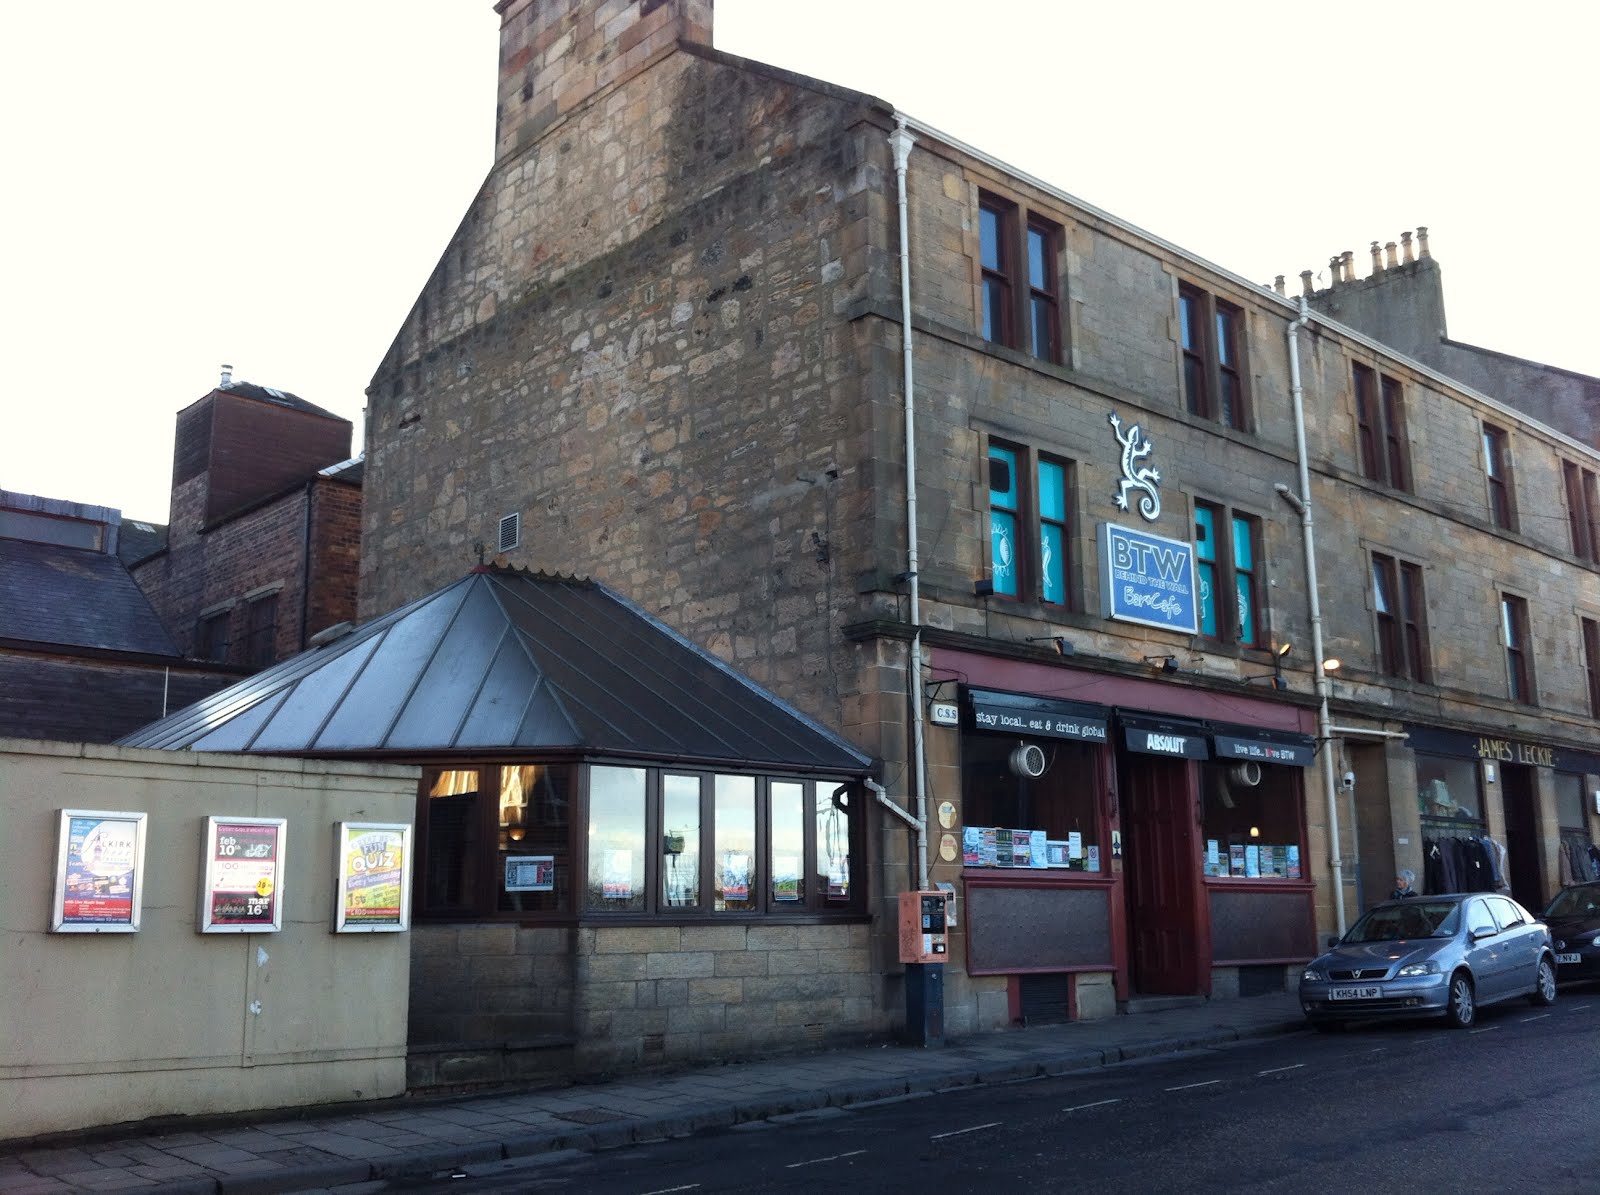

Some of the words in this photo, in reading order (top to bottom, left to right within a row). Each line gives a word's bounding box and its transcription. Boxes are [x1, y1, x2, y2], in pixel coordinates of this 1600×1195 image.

[1112, 534, 1187, 583] BTW
[1114, 568, 1148, 586] BEHIND
[1147, 576, 1166, 590] THE
[1164, 579, 1190, 595] WALL
[976, 711, 998, 726] stay
[1029, 719, 1043, 730] eat
[1056, 721, 1080, 735] drink
[1081, 725, 1106, 738] global
[1146, 733, 1186, 754] ABSOLUT
[1478, 738, 1514, 762] JAMES
[1517, 743, 1556, 767] LECKIE
[1280, 749, 1295, 761] BTW
[219, 836, 237, 845] feb
[352, 851, 396, 872] QUIZ
[248, 897, 270, 905] mar
[1336, 989, 1358, 999] KH54
[1360, 988, 1378, 998] LNP
